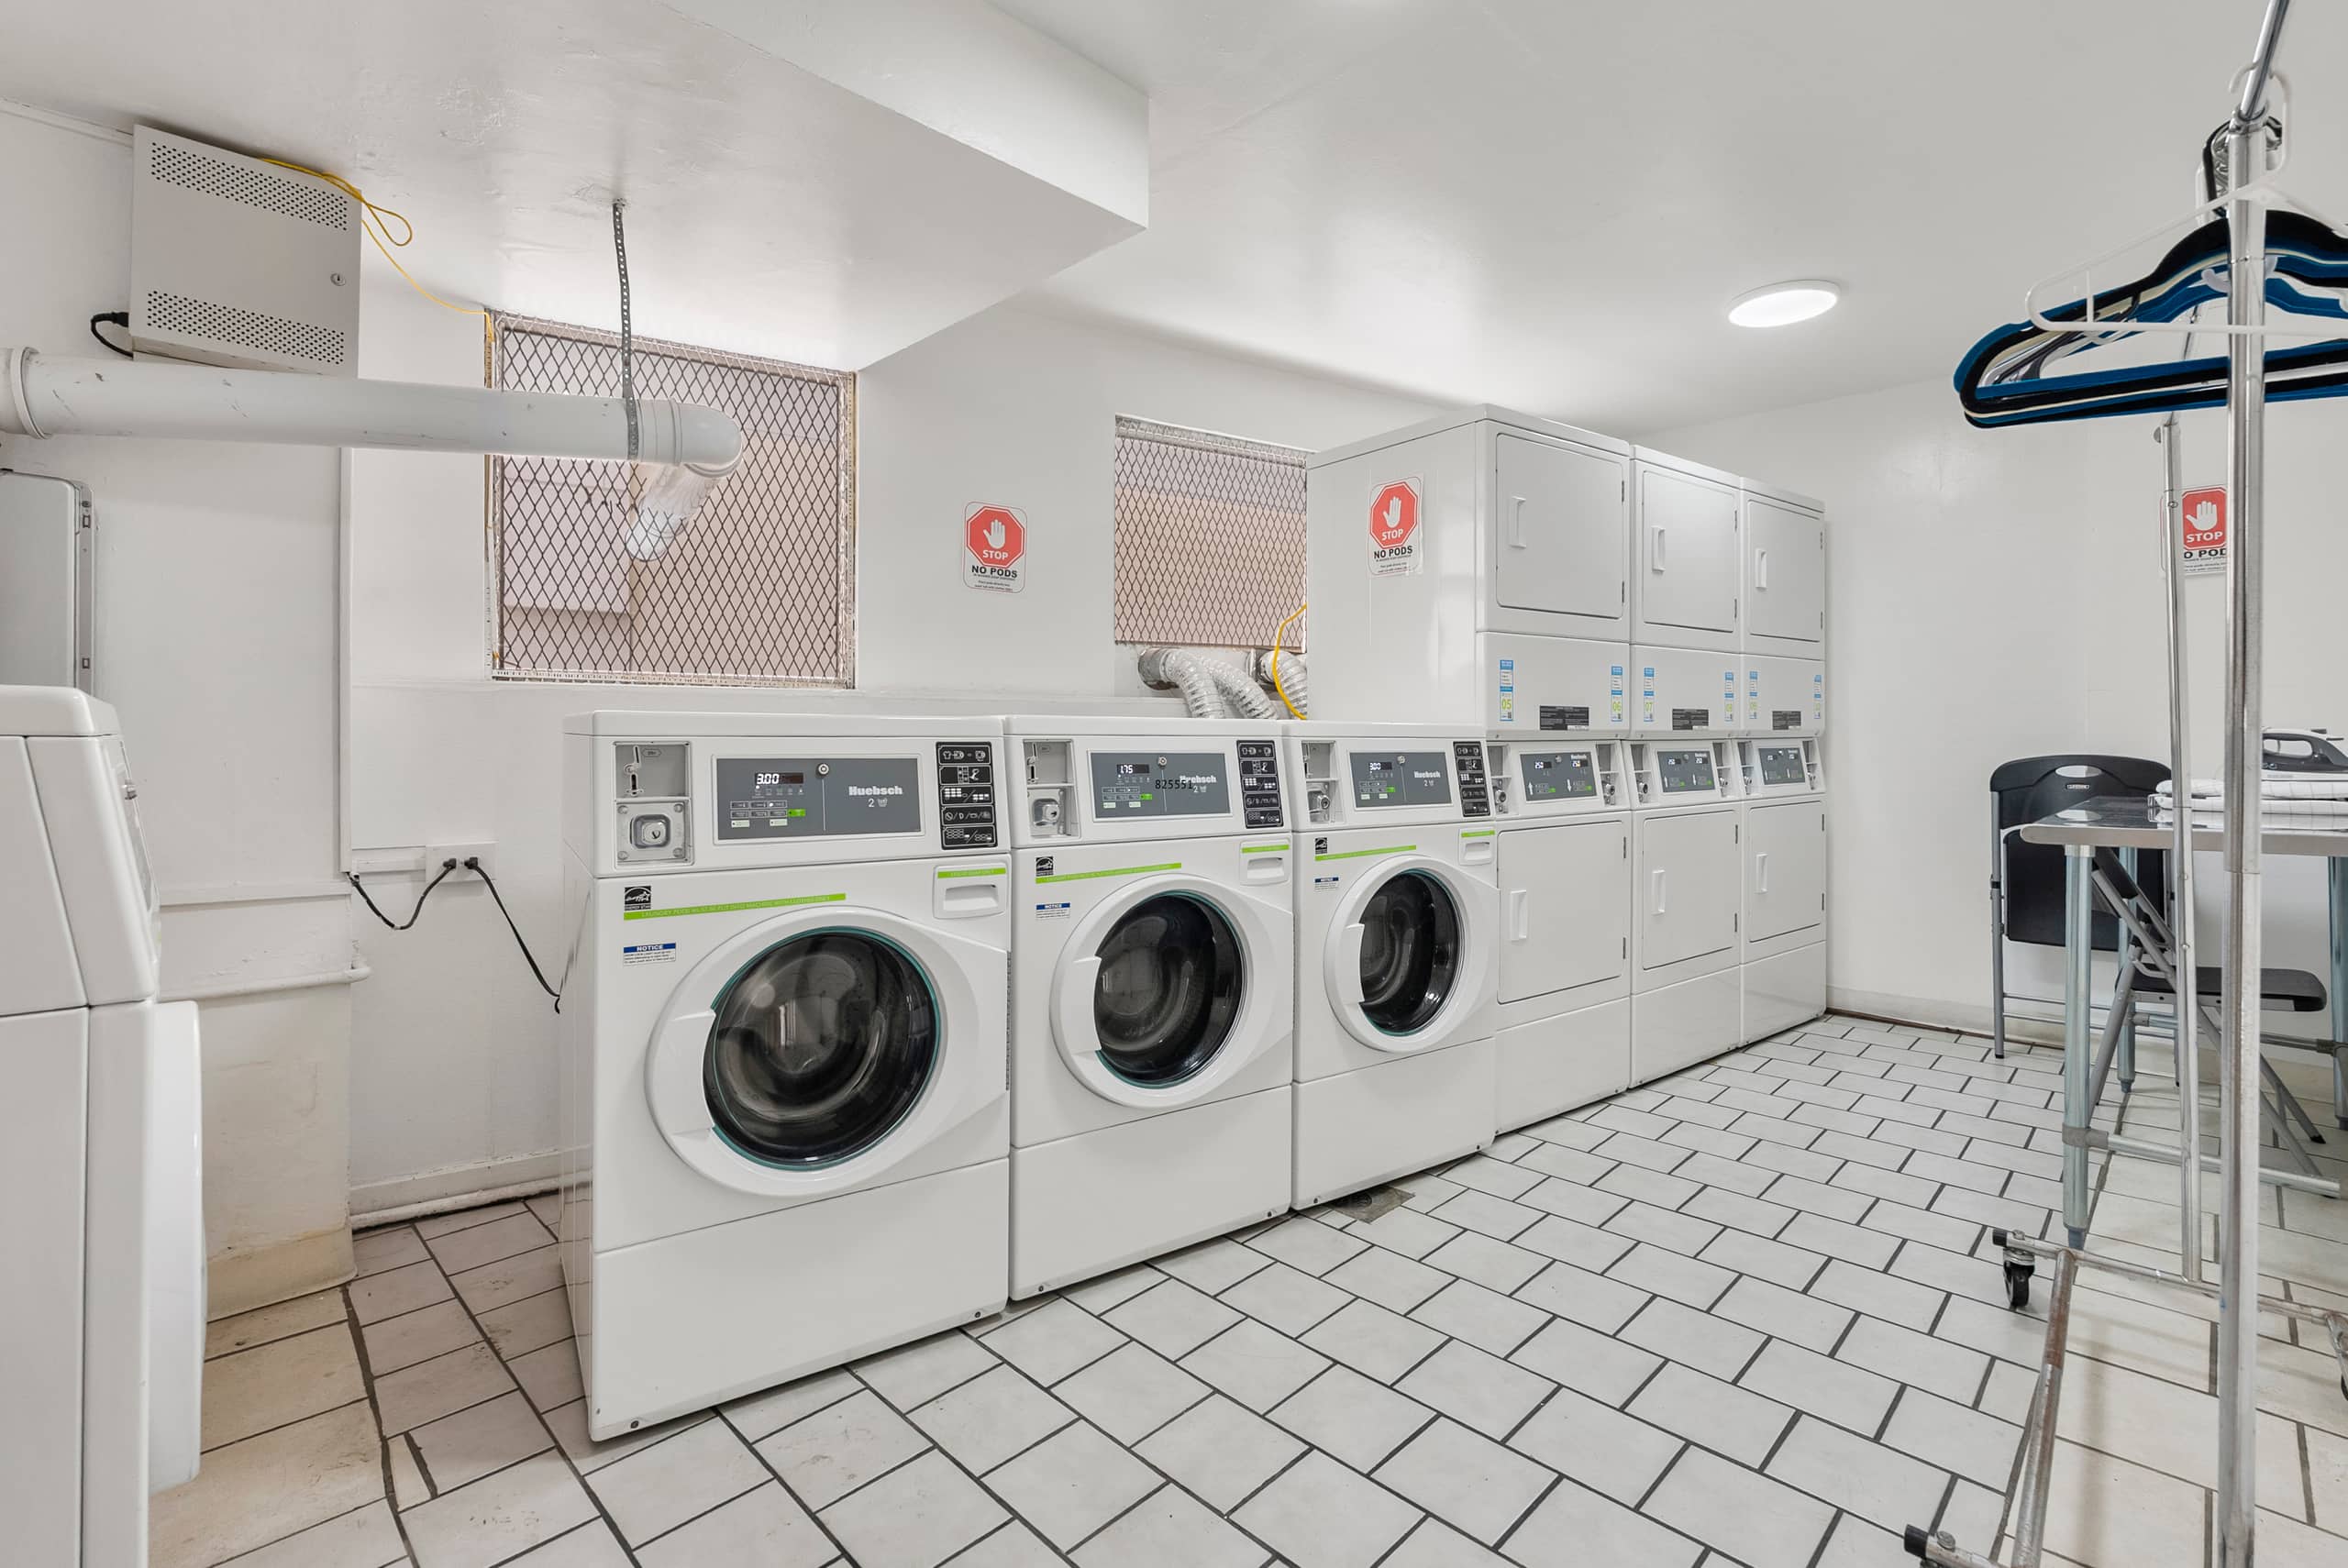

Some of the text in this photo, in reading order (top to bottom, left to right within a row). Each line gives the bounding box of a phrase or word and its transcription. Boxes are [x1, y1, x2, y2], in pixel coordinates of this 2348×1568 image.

[1381, 528, 1404, 541] STOP
[2186, 531, 2223, 543] STOP
[982, 549, 1009, 560] STOP
[1373, 549, 1387, 559] NO
[1389, 545, 1413, 557] PODS
[2183, 547, 2227, 558] O POD
[971, 565, 987, 574] NO
[990, 568, 1018, 579] PODS
[1501, 699, 1512, 710] 05
[1155, 779, 1193, 790] 825551
[848, 786, 903, 796] Huebsch
[868, 798, 875, 808] 2
